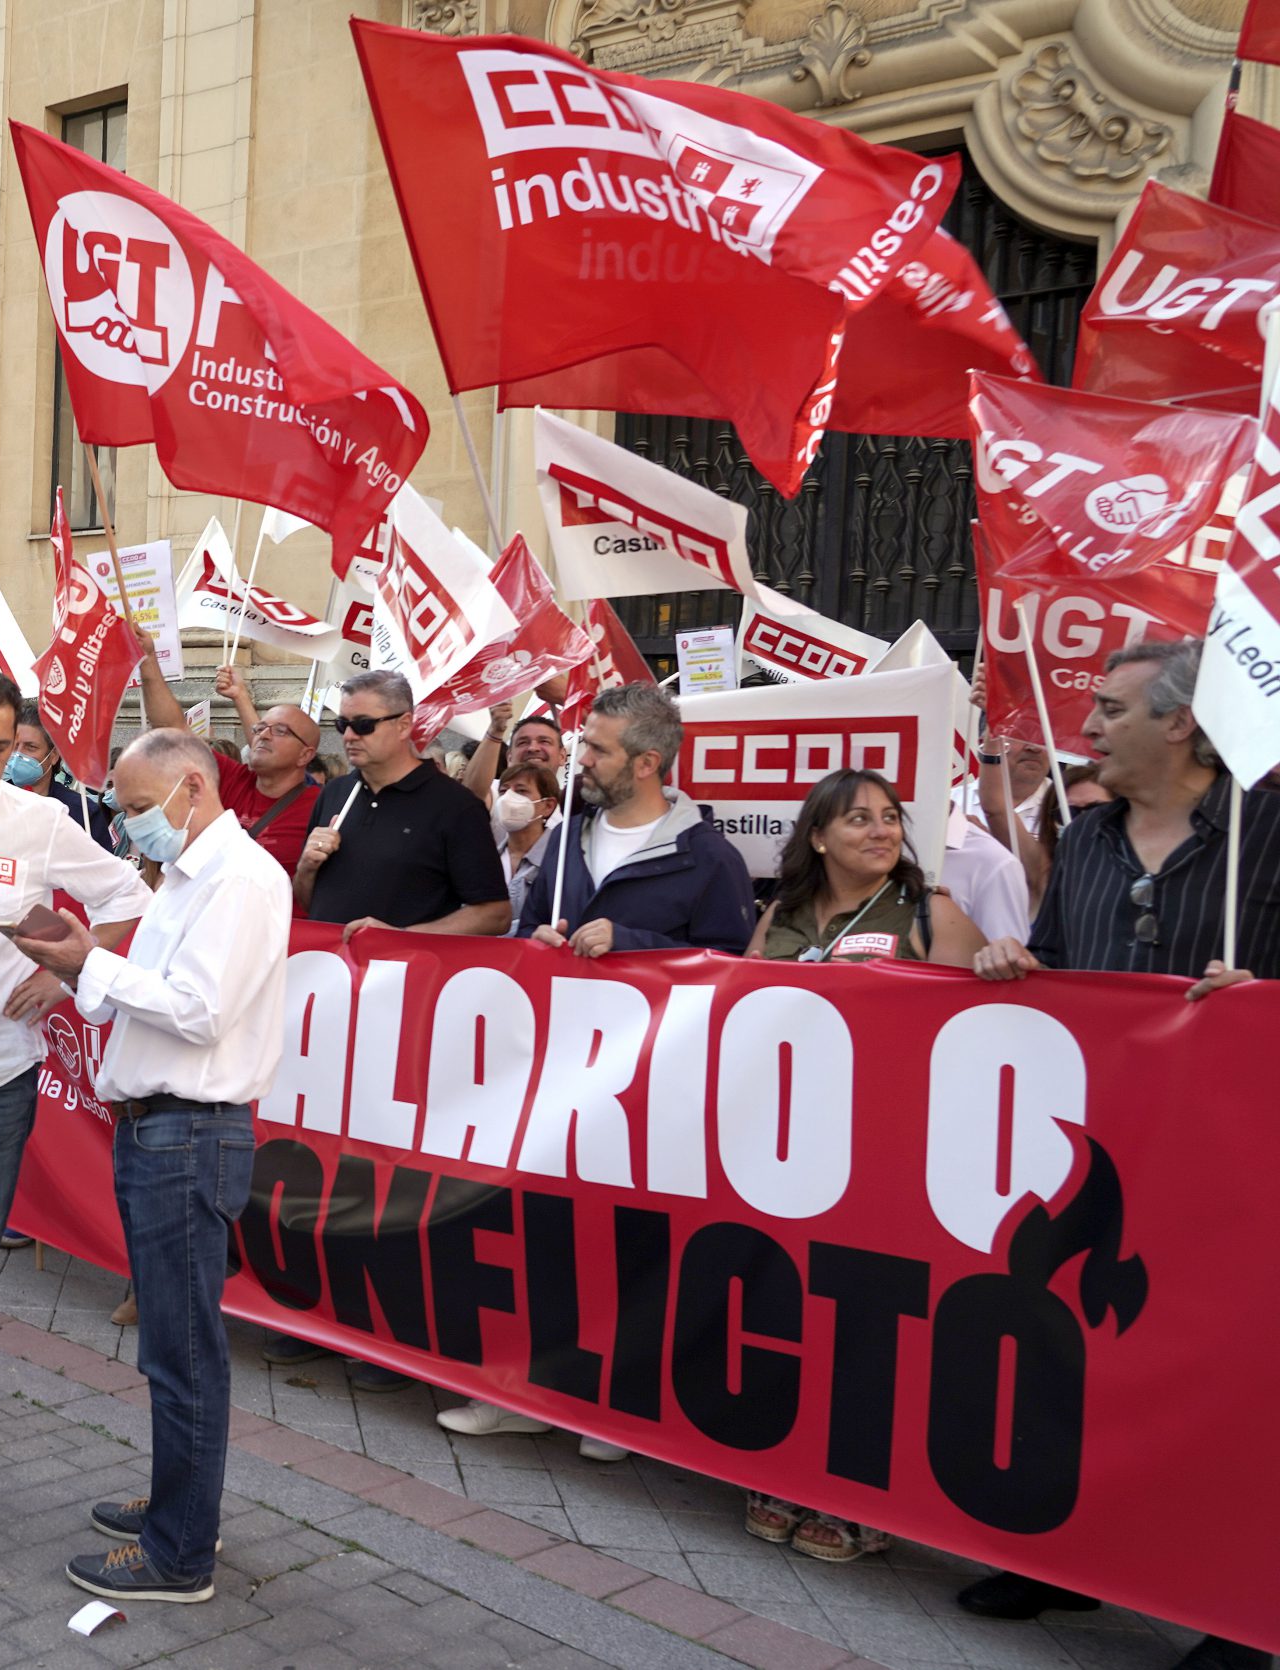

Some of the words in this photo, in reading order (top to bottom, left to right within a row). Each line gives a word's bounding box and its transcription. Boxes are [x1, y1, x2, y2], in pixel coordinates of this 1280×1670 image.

[62, 217, 170, 327] UGT
[1099, 249, 1276, 331] UGT
[355, 445, 401, 493] Agro
[750, 622, 856, 679] CCOO
[986, 588, 1168, 659] UGT
[692, 731, 901, 784] CCOO
[713, 813, 783, 836] astilla
[844, 936, 888, 946] CCOO
[63, 1085, 78, 1111] y
[81, 1085, 113, 1126] León
[258, 950, 854, 1219] ALARIO
[227, 1138, 1087, 1535] ONFLICTO
